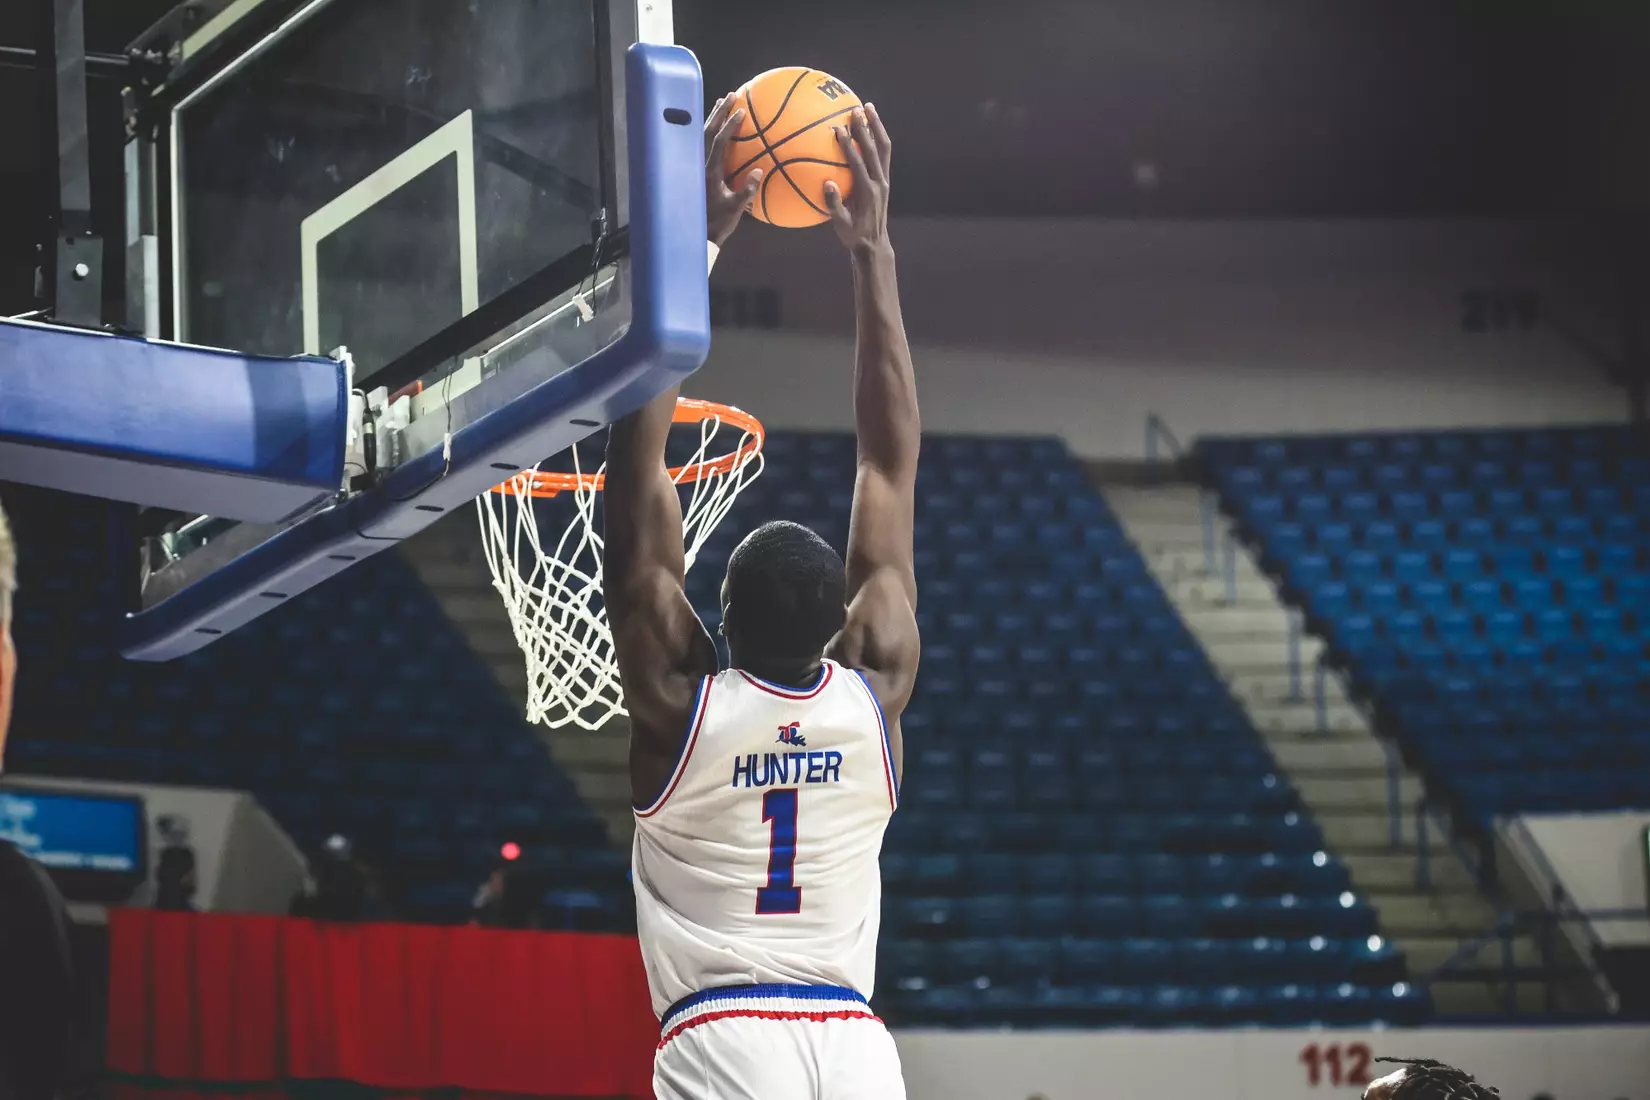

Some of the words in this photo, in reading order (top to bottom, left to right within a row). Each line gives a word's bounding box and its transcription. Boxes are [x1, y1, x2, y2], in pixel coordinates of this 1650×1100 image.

[732, 751, 843, 788] HUNTER
[755, 788, 802, 914] 1
[1299, 1042, 1372, 1086] 112
